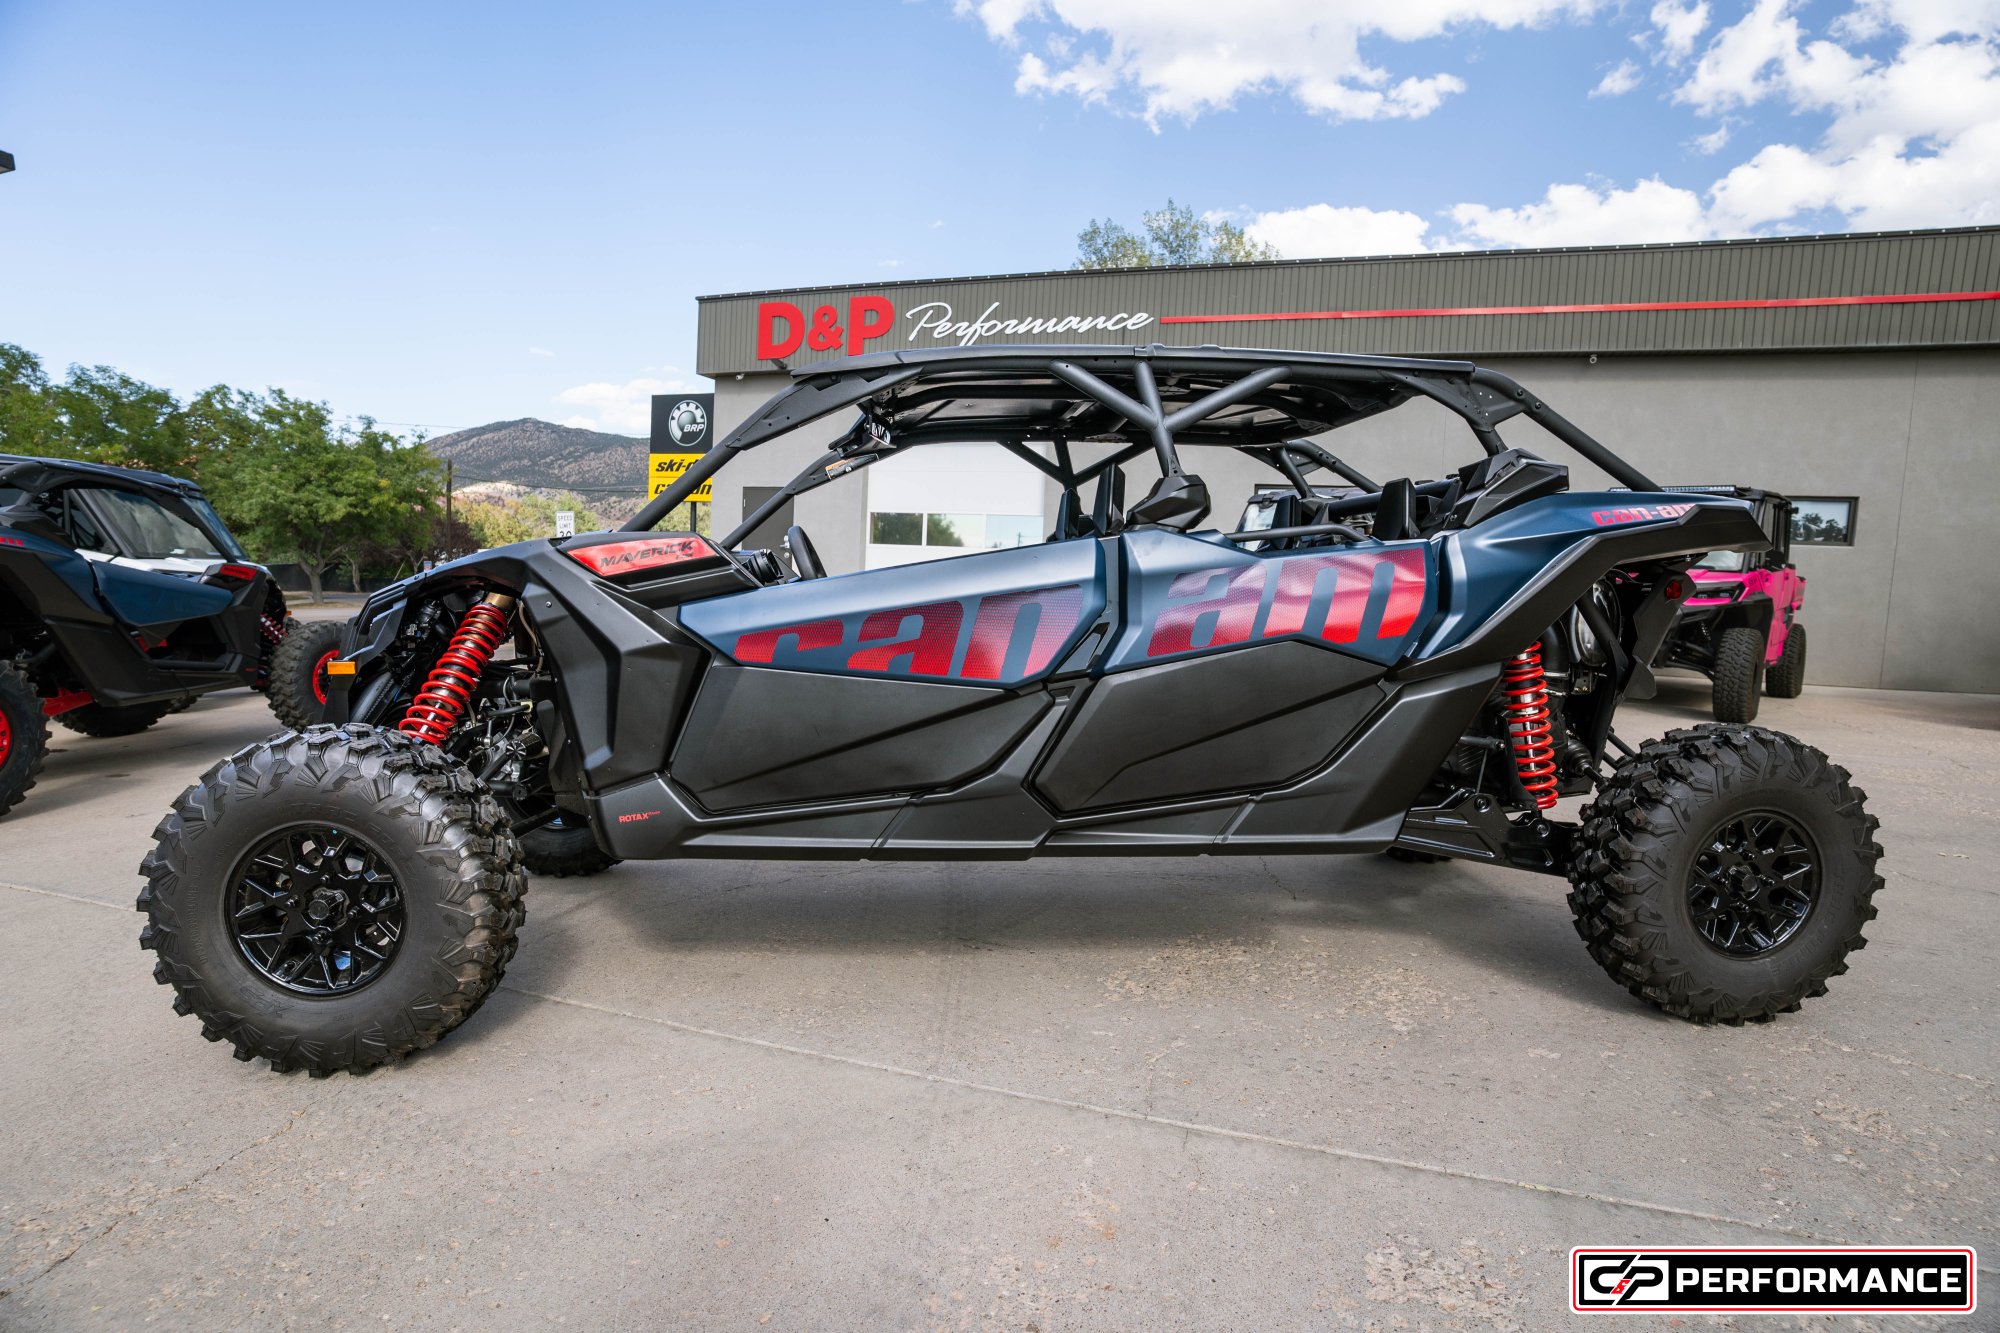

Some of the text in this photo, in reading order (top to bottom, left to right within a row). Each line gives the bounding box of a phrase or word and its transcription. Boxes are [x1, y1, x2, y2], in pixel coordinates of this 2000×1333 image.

[757, 295, 1154, 360] D&P Performance
[683, 424, 705, 433] BRP
[600, 540, 695, 567] MAVERICK
[618, 812, 649, 823] ROTAX
